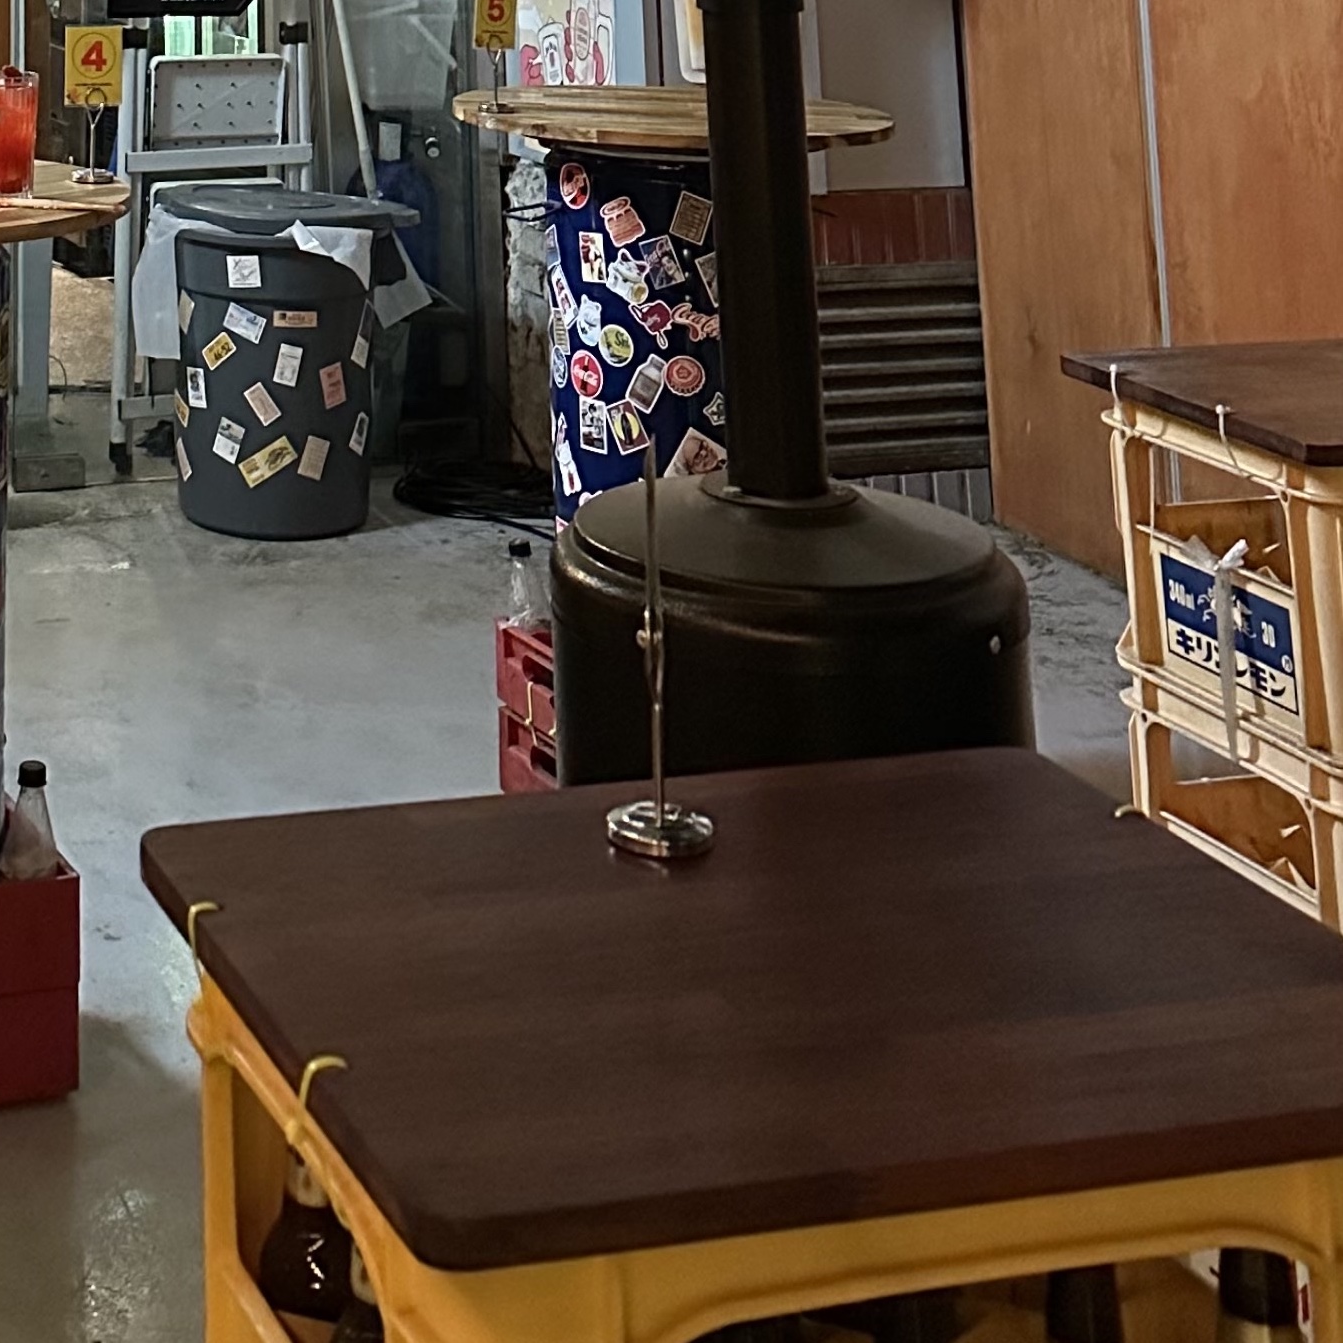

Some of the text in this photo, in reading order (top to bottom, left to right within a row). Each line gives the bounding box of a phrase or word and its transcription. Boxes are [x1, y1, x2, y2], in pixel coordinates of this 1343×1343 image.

[81, 40, 107, 71] 4
[1176, 628, 1286, 697] キリモン
